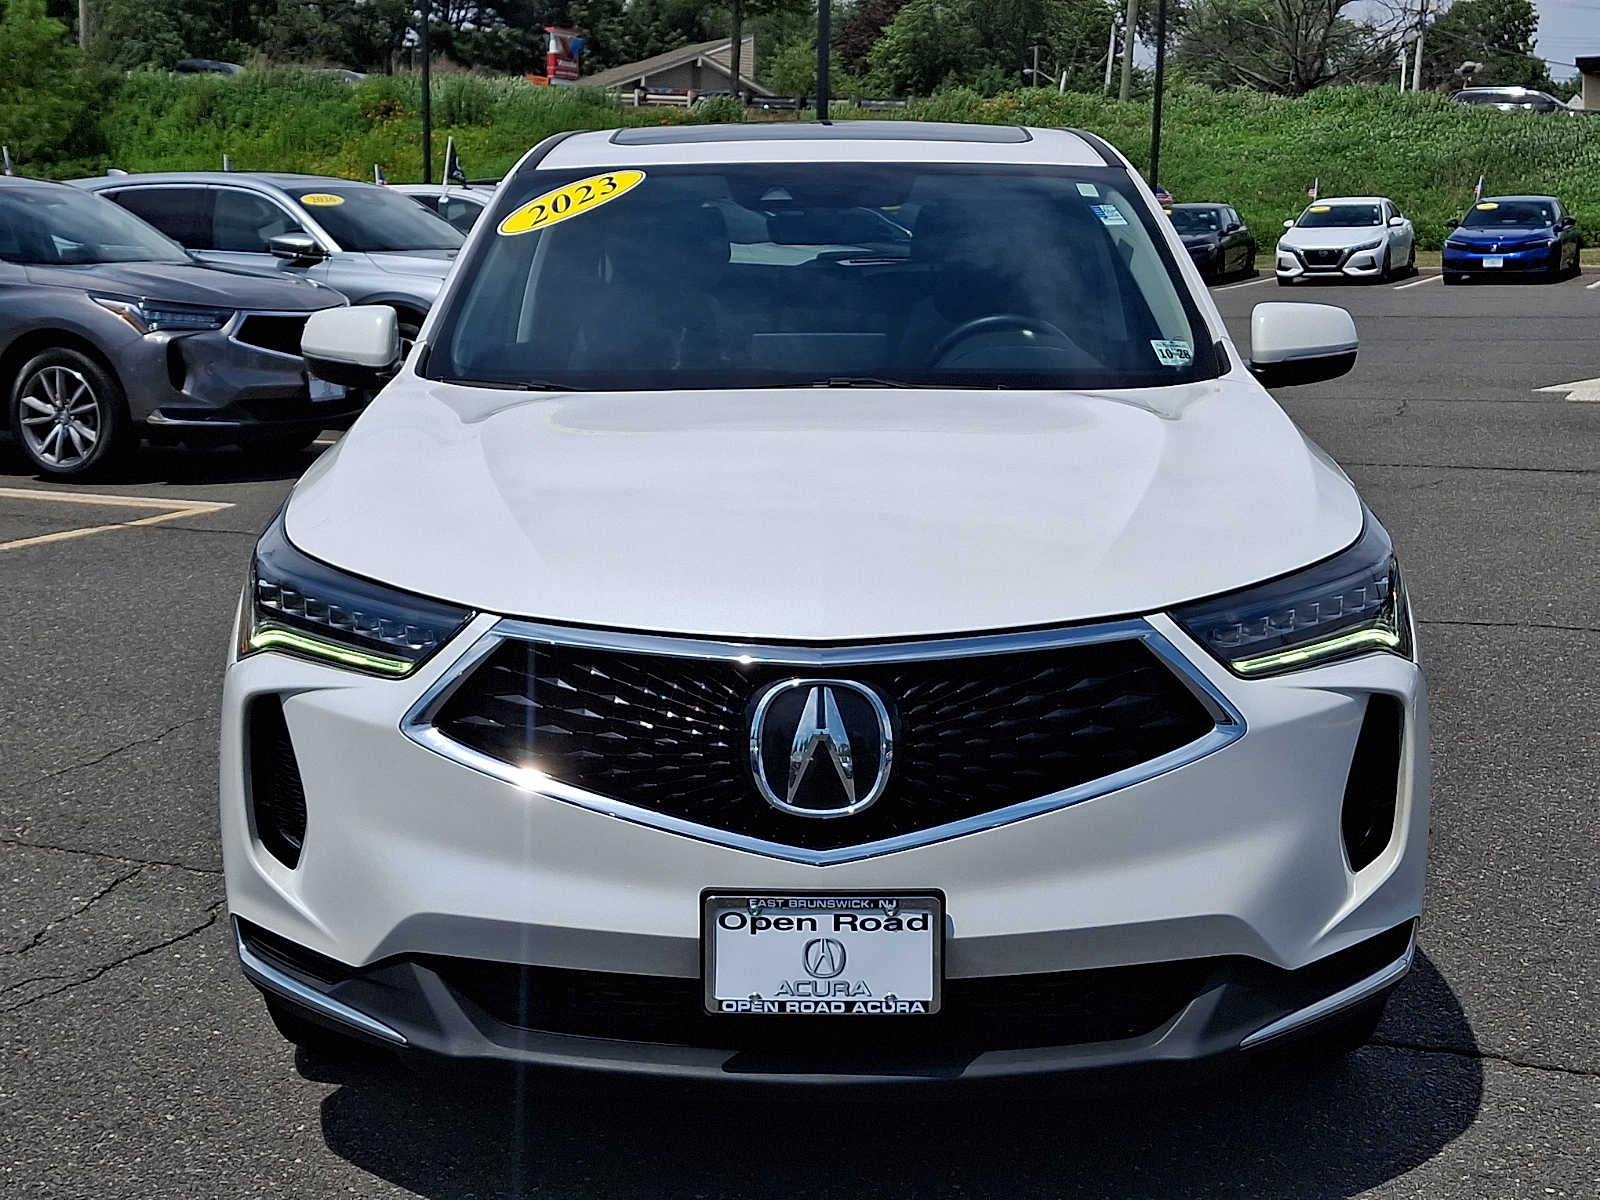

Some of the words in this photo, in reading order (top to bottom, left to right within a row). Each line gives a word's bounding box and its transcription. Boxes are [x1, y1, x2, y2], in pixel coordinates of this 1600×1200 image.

[527, 176, 618, 226] 2023
[749, 899, 785, 908] EAST
[879, 899, 897, 909] NJ
[718, 911, 817, 935] Open
[833, 913, 929, 932] Road
[774, 980, 872, 997] ACURA
[722, 1001, 779, 1013] OPEN
[786, 1001, 845, 1013] ROAD
[852, 1001, 926, 1013] ACURA
